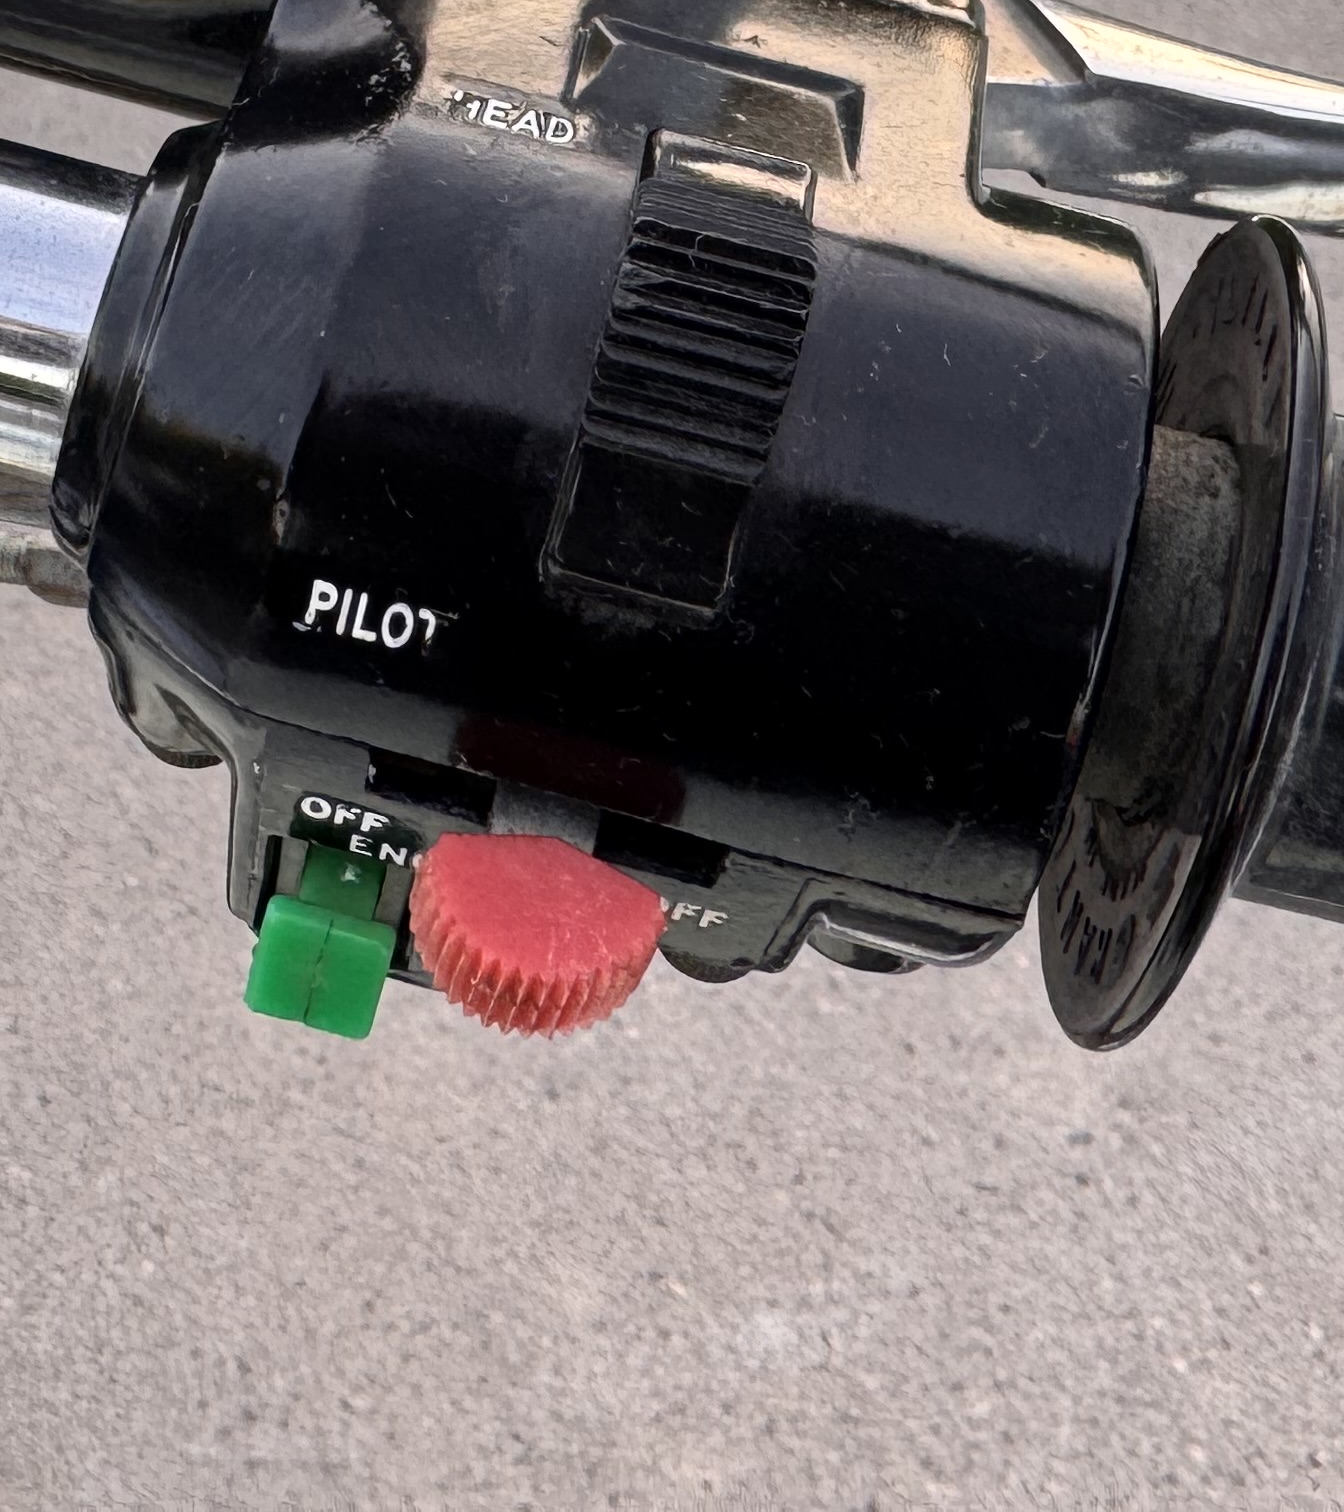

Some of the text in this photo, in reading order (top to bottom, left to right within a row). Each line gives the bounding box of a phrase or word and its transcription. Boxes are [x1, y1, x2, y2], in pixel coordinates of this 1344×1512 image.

[302, 578, 442, 651] PILOT
[300, 796, 394, 833] OFF
[349, 834, 423, 867] EN
